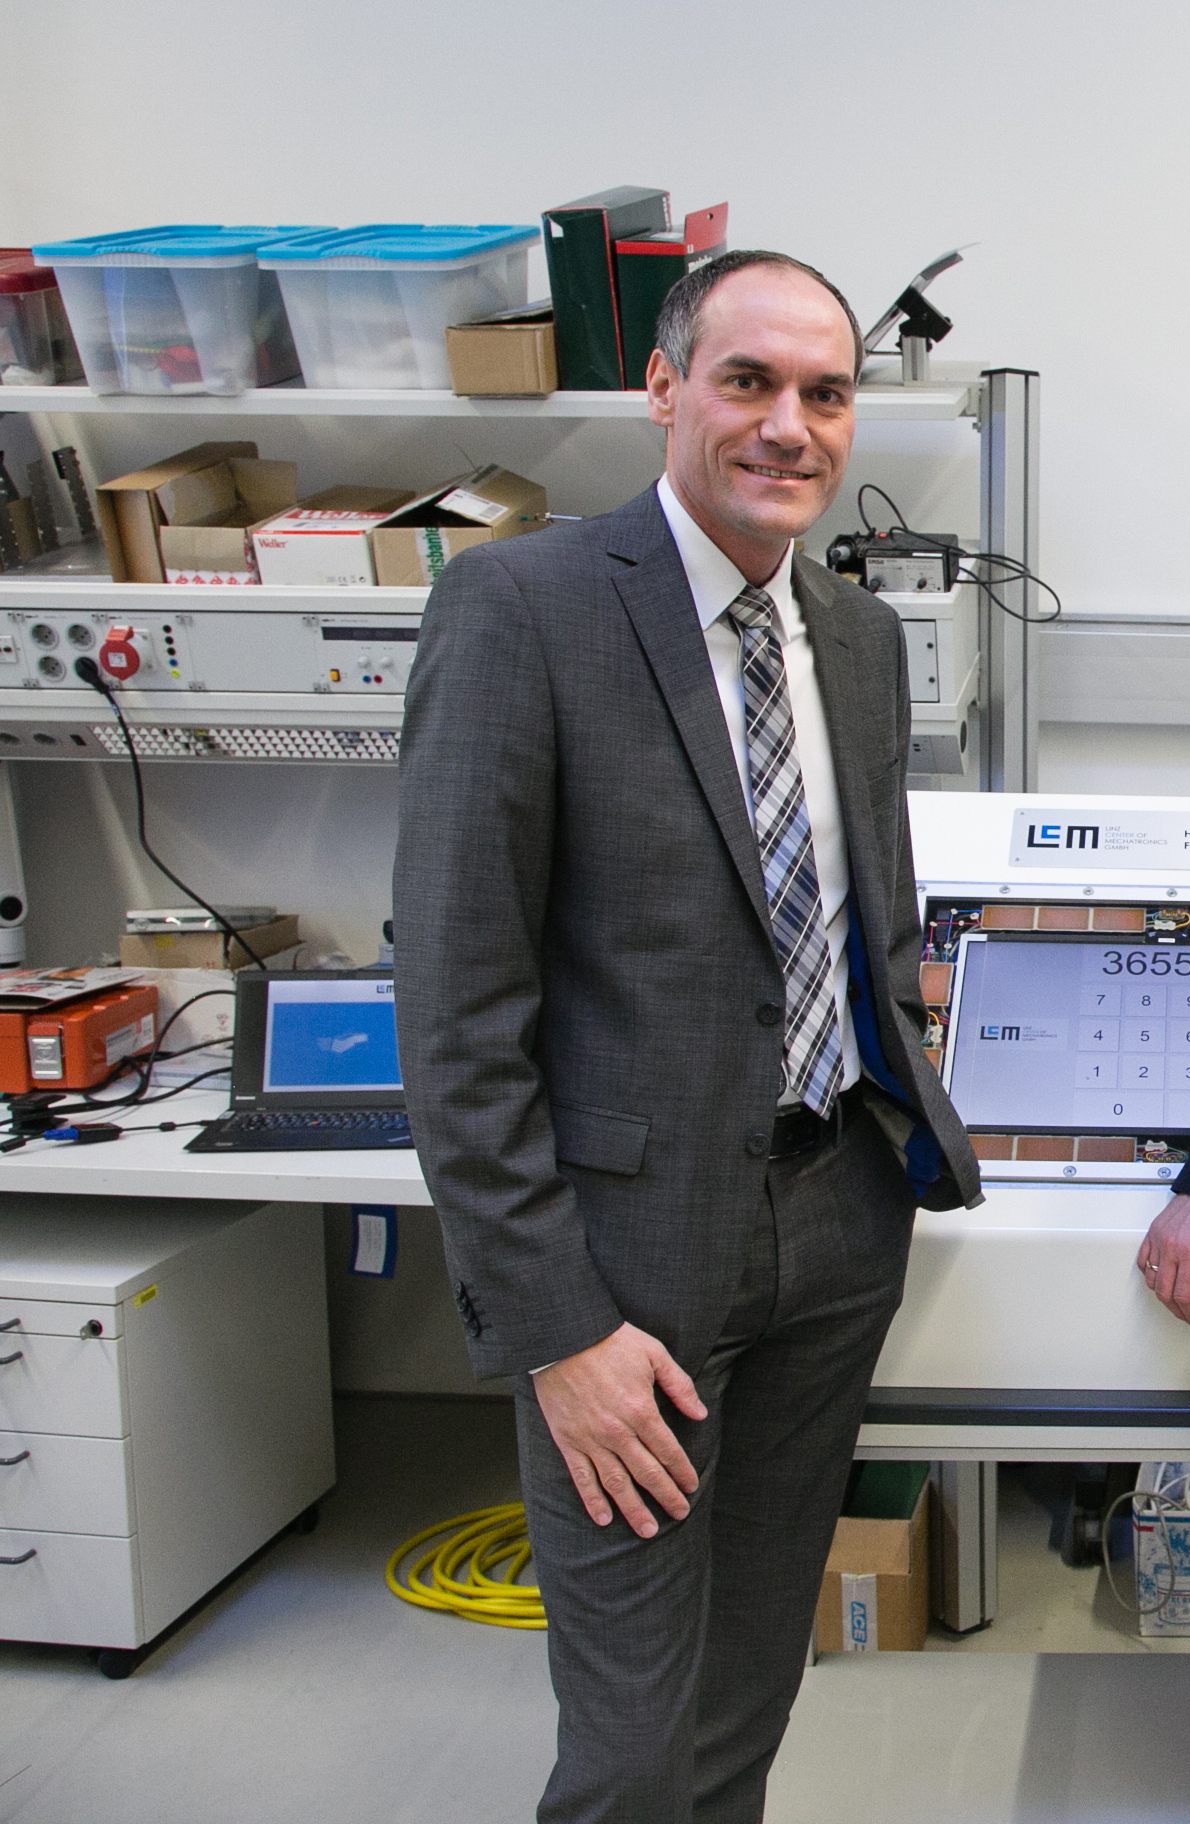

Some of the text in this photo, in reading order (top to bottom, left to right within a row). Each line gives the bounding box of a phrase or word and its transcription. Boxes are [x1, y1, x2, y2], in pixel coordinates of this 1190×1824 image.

[258, 538, 287, 548] Weller
[1096, 994, 1106, 1006] 7
[1141, 995, 1151, 1006] 8
[1093, 1030, 1103, 1041] 4
[1140, 1030, 1150, 1042] 5
[1093, 1066, 1100, 1078] 1
[1138, 1066, 1149, 1078] 2
[1113, 1103, 1124, 1116] 0
[852, 1603, 866, 1642] ACE
